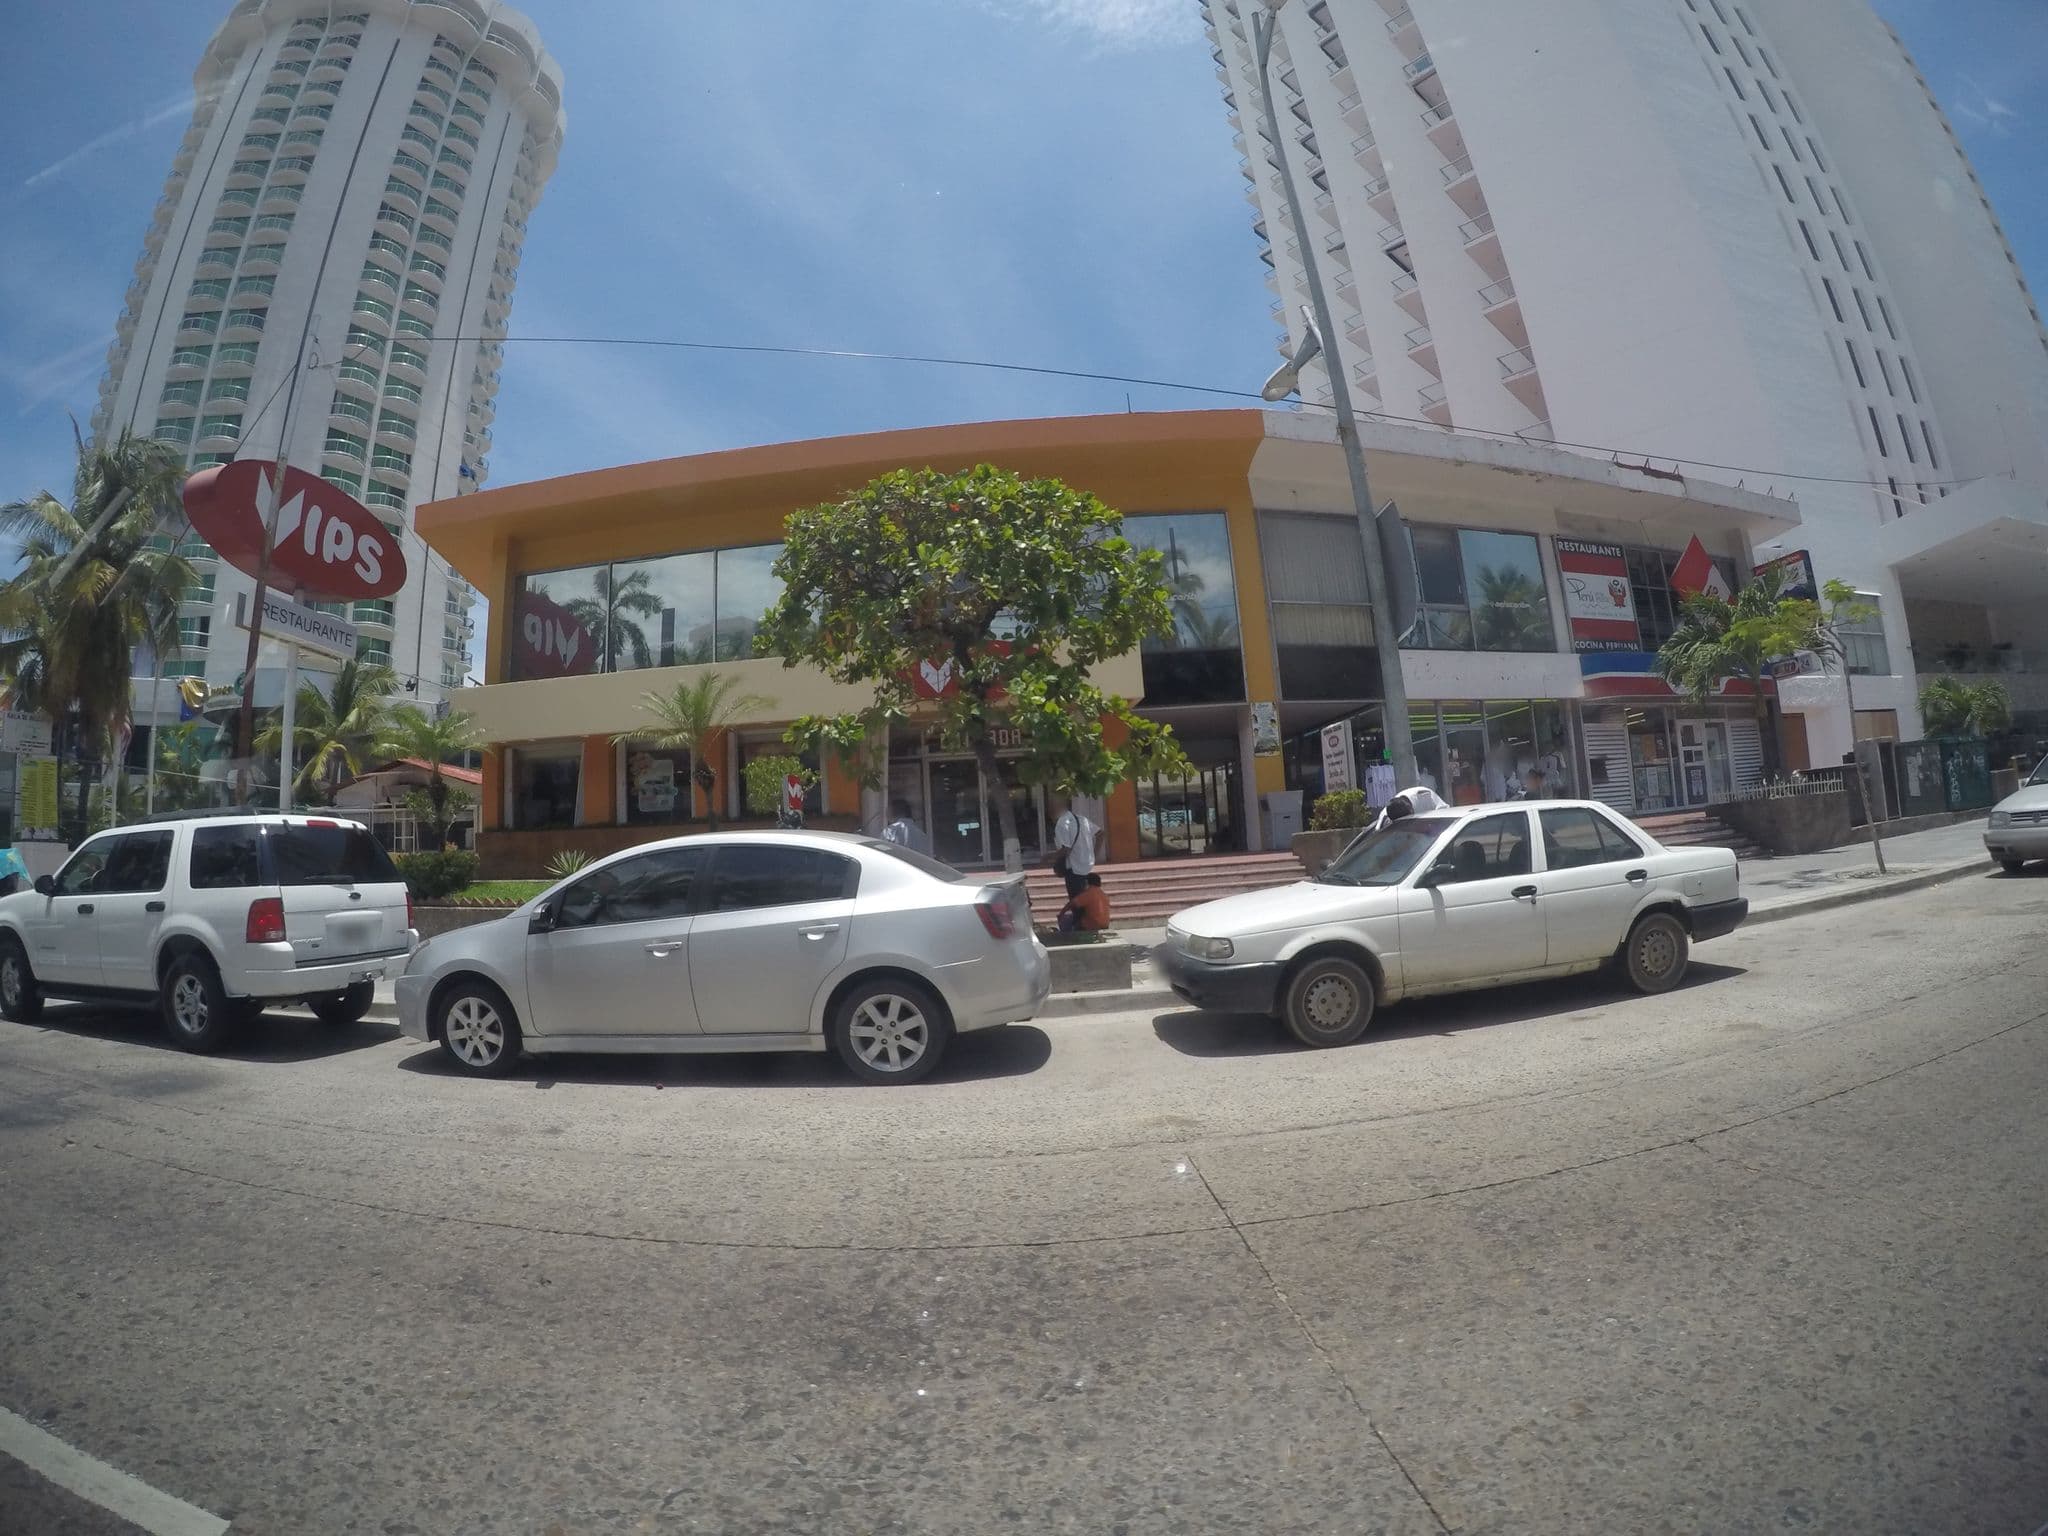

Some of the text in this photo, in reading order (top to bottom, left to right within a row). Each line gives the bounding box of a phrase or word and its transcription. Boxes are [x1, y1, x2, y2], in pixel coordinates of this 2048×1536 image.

[1558, 541, 1622, 557] RESTAURANTE
[262, 602, 353, 648] RESTAURANTE
[1574, 641, 1604, 650] COCINA
